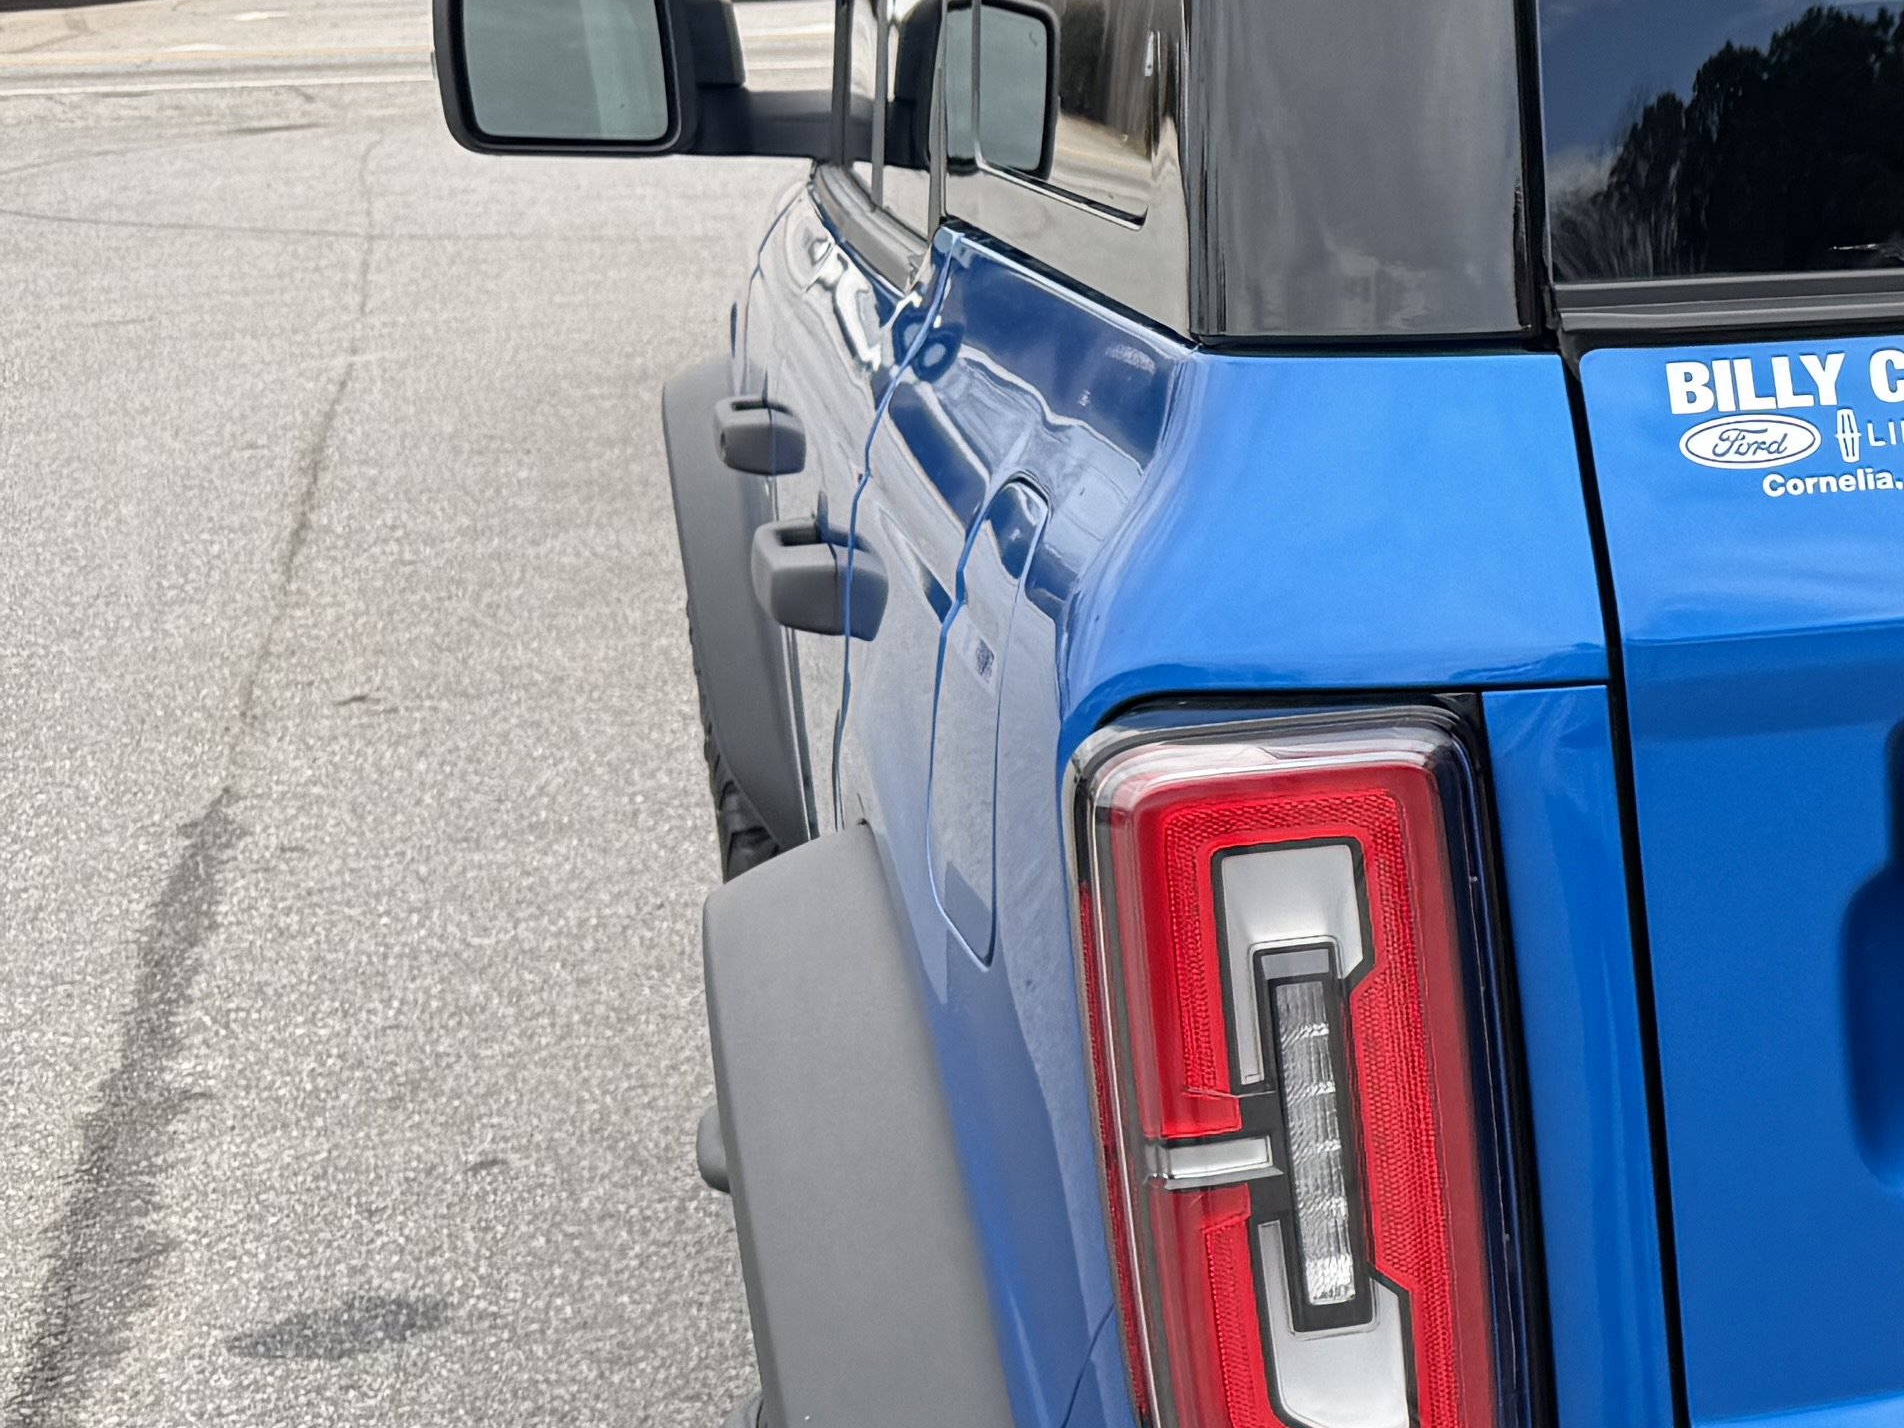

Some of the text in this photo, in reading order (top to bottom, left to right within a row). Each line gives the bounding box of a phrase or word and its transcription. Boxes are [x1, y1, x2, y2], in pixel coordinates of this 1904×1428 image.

[1665, 353, 1846, 414] BILLY
[1711, 427, 1788, 459] Ford
[1762, 466, 1904, 498] Cornelia,
